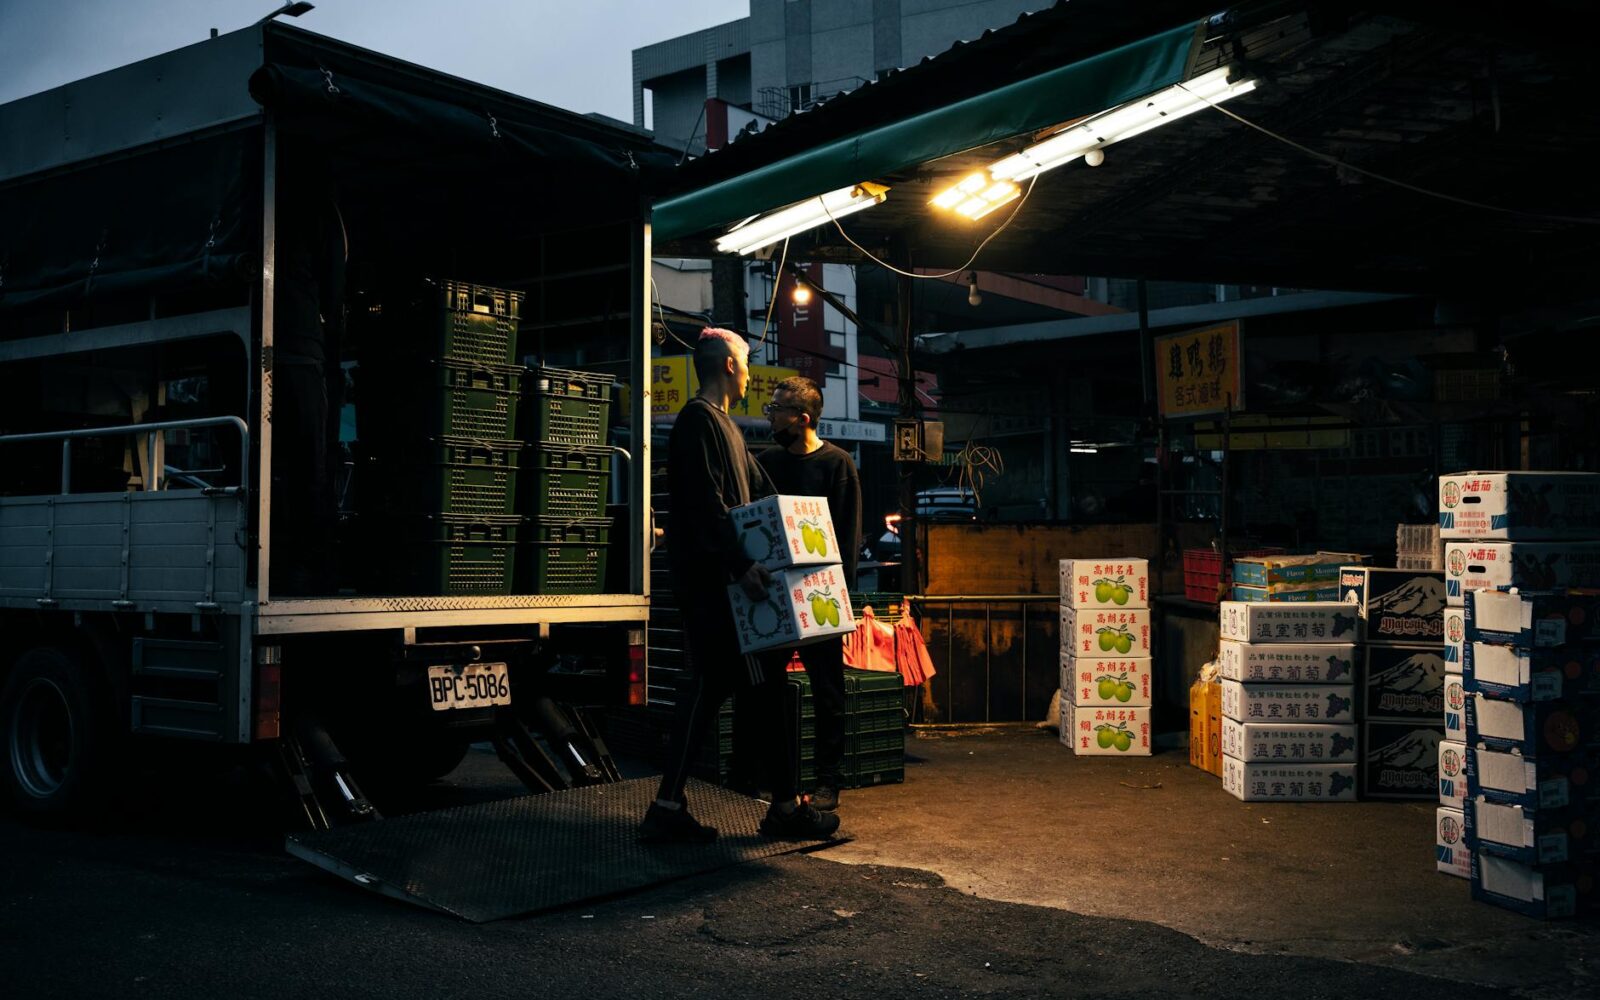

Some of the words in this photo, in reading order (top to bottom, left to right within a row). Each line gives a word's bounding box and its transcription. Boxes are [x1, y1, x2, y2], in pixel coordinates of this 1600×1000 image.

[1461, 480, 1492, 492] 小番茄
[1467, 548, 1497, 561] 小番茄
[1257, 623, 1326, 638] 溫室葡萄
[1248, 665, 1320, 681] 溫室葡萄
[1248, 703, 1319, 718] 溫室葡萄
[1252, 743, 1323, 758] 溫室葡萄
[1251, 781, 1322, 796] 溫室葡萄
